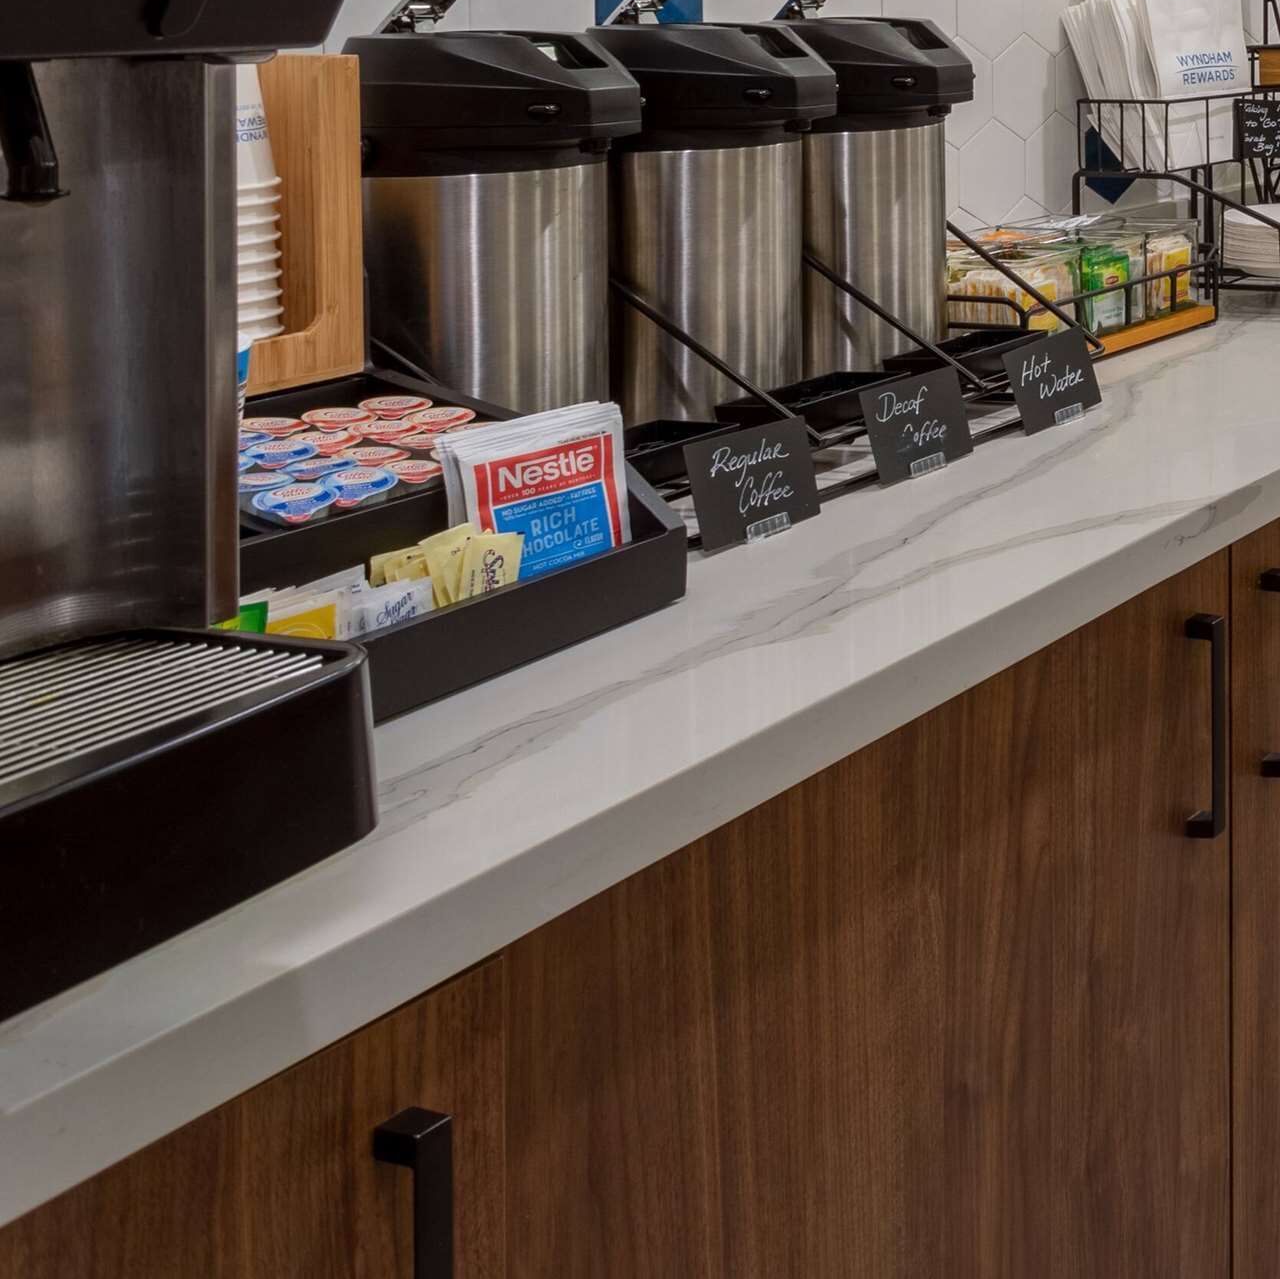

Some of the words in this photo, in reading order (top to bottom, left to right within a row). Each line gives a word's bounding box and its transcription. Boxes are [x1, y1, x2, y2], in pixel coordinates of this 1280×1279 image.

[1176, 51, 1233, 67] WYNDHAM
[1182, 69, 1235, 86] REWARDS
[1021, 352, 1052, 387] Hot
[1040, 365, 1084, 399] Water
[875, 385, 929, 423] Decaf
[498, 446, 595, 492] Nestlé
[710, 438, 790, 487] Regular
[521, 487, 536, 496] 100
[739, 470, 795, 514] Coffee
[531, 506, 576, 537] RICH
[376, 592, 412, 626] Sugar
